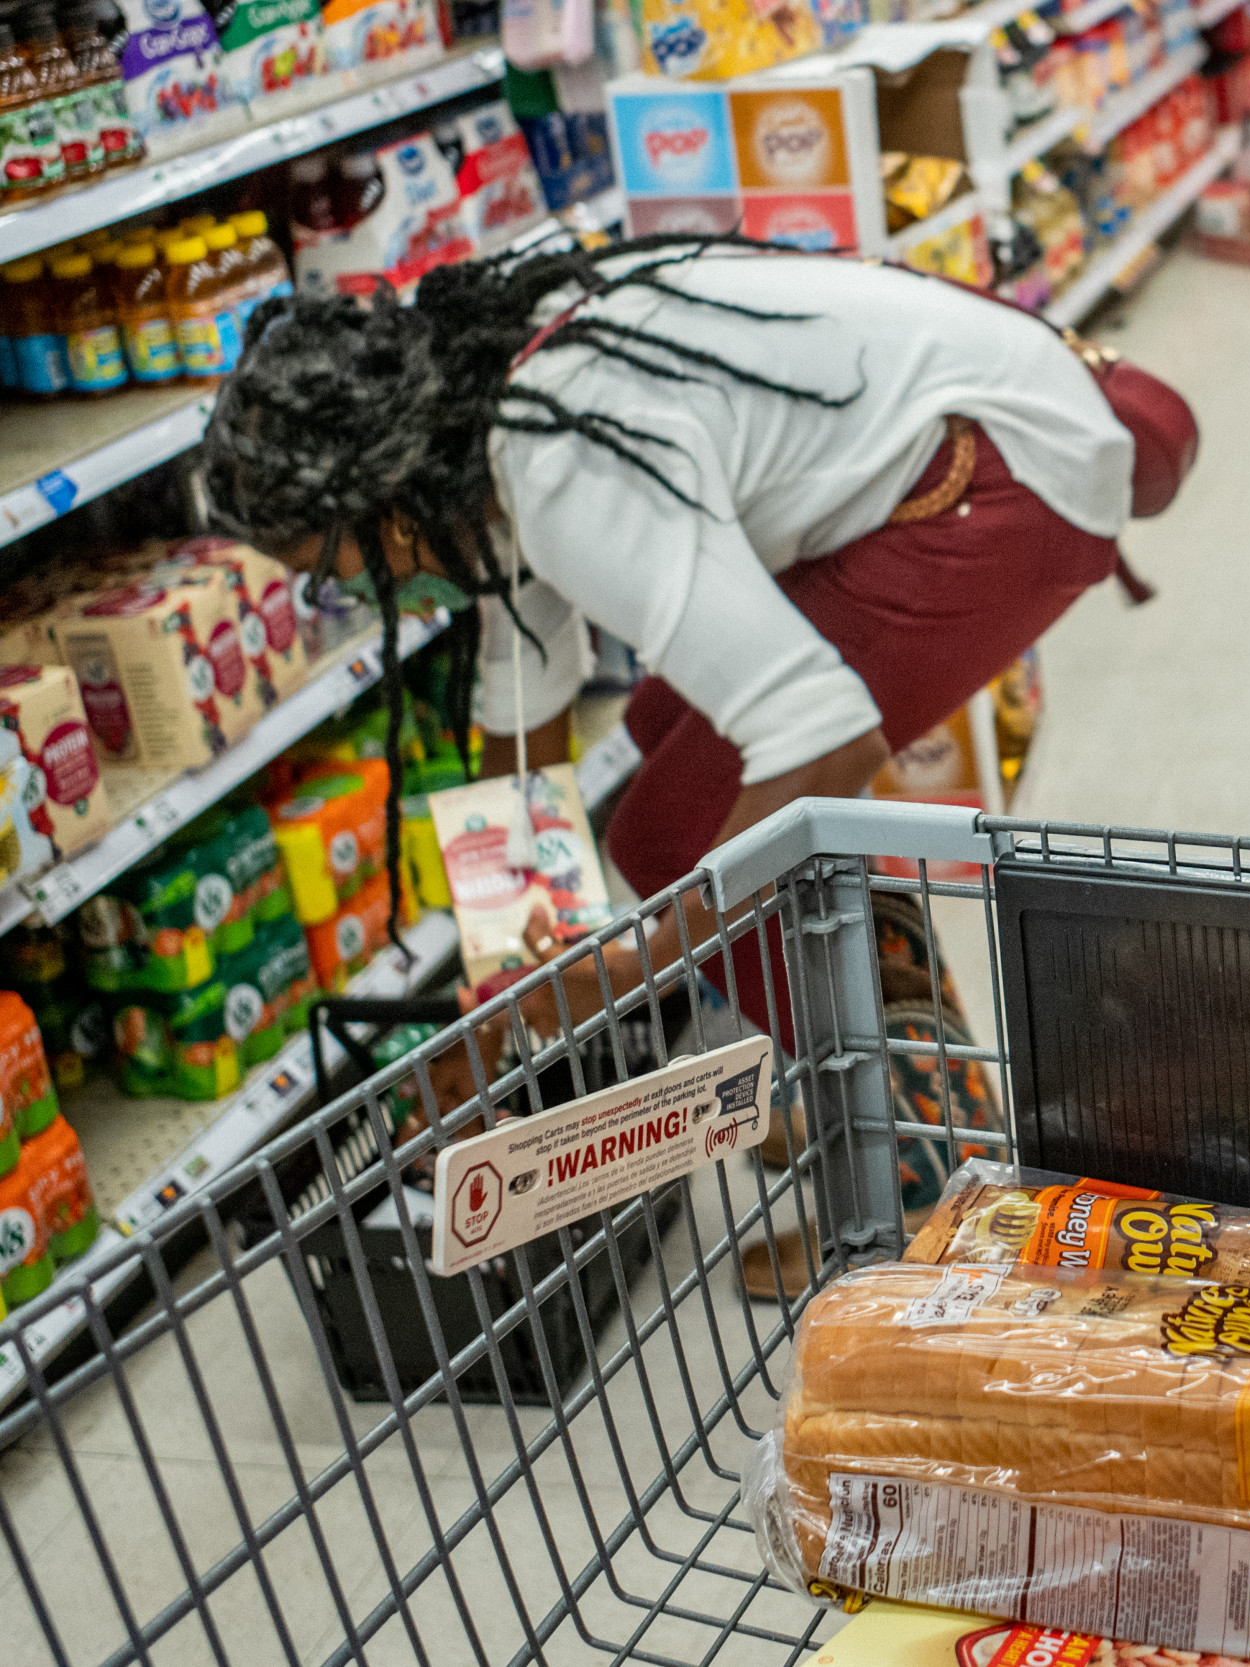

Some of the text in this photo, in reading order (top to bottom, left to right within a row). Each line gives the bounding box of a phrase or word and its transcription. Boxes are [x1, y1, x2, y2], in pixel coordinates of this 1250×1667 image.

[722, 1081, 754, 1098] PROTECTION
[737, 1074, 755, 1085] ASSET
[508, 1132, 544, 1154] Shopping
[544, 1125, 564, 1139] Carts
[565, 1120, 580, 1132] may
[581, 1113, 597, 1126] stop
[598, 1097, 643, 1121] unexpectedly
[651, 1088, 664, 1102] exit
[664, 1082, 683, 1096] doors
[684, 1076, 695, 1088] and
[695, 1070, 712, 1083] carts
[712, 1065, 724, 1078] will
[726, 1096, 754, 1111] INSTALLED
[536, 1142, 552, 1157] stop
[560, 1130, 580, 1146] taken
[581, 1121, 607, 1139] beyond
[608, 1116, 619, 1128] the
[620, 1106, 652, 1125] perimeter
[661, 1096, 671, 1107] the
[672, 1089, 696, 1106] parking
[465, 1210, 489, 1229] STOP
[1120, 1210, 1169, 1275] Ow
[1163, 1203, 1216, 1277] Natu
[882, 1484, 898, 1508] 60
[1001, 1639, 1028, 1666] HEART
